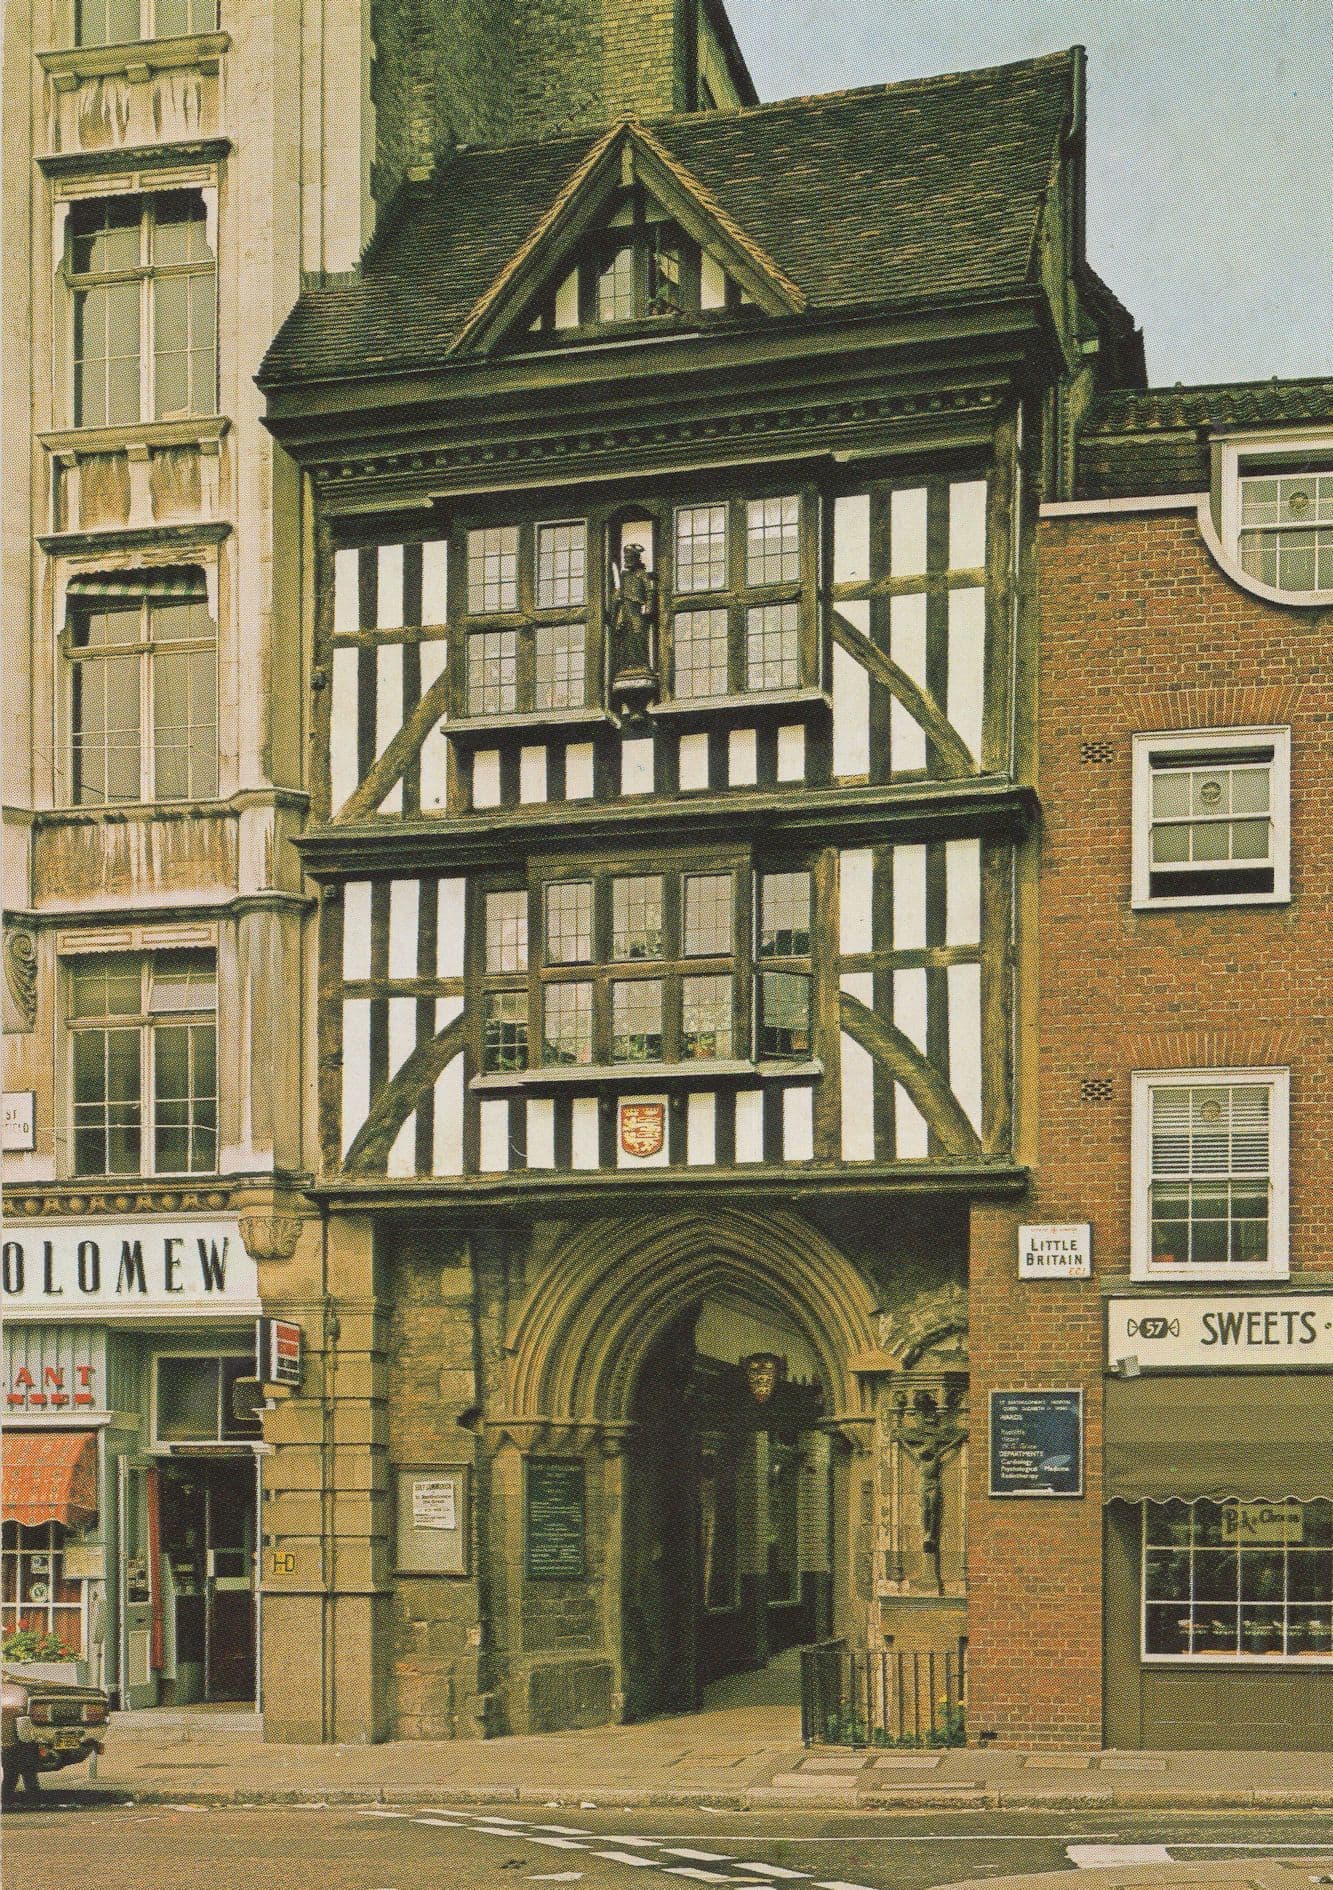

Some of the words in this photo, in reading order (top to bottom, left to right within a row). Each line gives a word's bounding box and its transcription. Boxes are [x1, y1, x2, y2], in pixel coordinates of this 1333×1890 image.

[1031, 1238, 1077, 1251] LITTLE
[2, 1237, 229, 1293] OLOMEW
[1026, 1253, 1082, 1265] BRITAIN
[1145, 1321, 1164, 1336] 57
[1200, 1311, 1317, 1345] SWEETS
